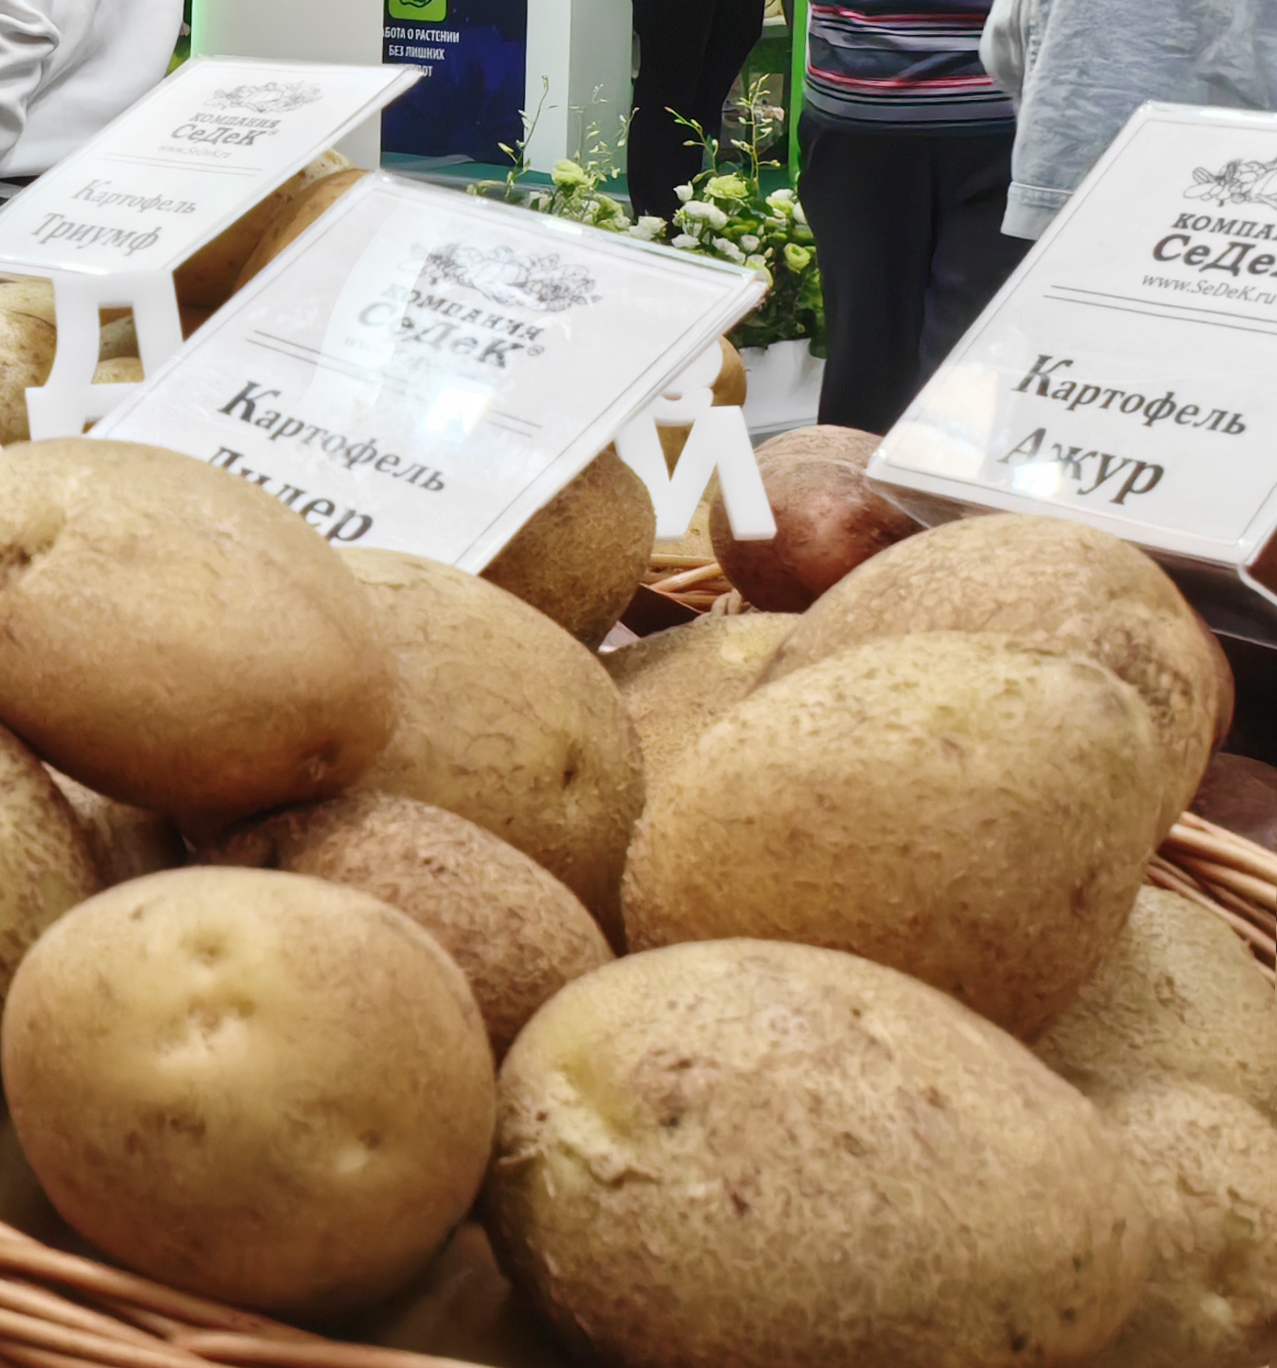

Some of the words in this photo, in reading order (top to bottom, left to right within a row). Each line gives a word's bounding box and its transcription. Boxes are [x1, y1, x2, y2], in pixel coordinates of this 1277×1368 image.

[385, 27, 405, 39] БОТА
[389, 45, 404, 56] БЕЗ
[405, 46, 445, 60] ЛИШНИХ
[189, 113, 281, 129] КОМПАНИЯ
[71, 179, 196, 214] Картофель
[31, 212, 162, 257] Триумф
[1171, 213, 1277, 241] КОМПА
[1153, 234, 1277, 277] СеДе
[1142, 272, 1276, 305] www.SeDeK.ru
[1012, 354, 1248, 435] Картофель
[217, 381, 446, 492] Картофель
[997, 427, 1164, 505] Ажур
